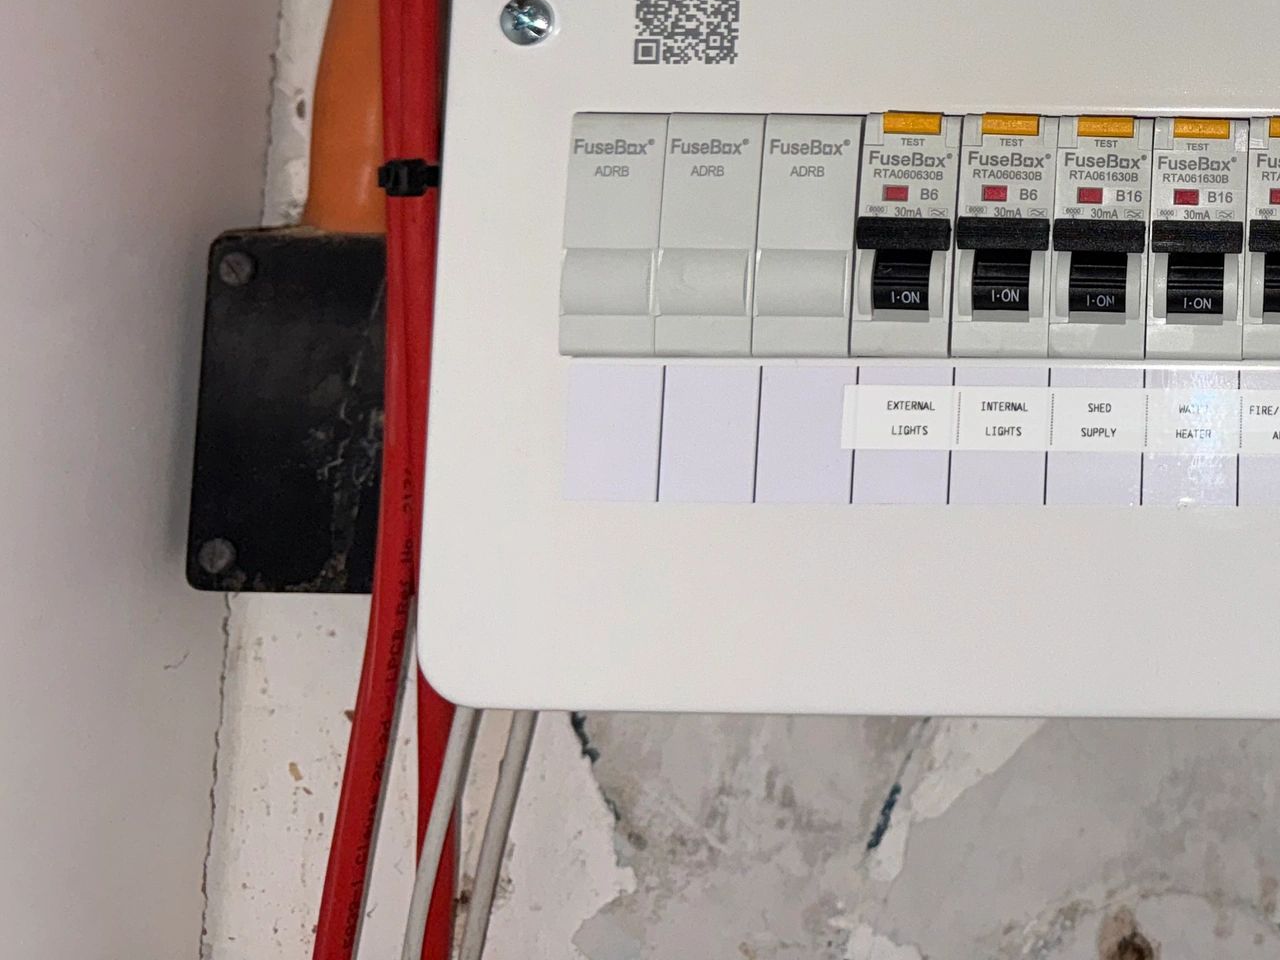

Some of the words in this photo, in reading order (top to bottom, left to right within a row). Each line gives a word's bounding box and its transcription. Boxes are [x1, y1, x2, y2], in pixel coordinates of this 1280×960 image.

[901, 138, 926, 147] TEST
[1000, 138, 1024, 147] TEST
[1095, 140, 1118, 148] TEST
[1186, 143, 1210, 151] TEST
[594, 166, 630, 177] ADRB
[690, 165, 725, 177] ADRB
[790, 166, 825, 178] ADRB
[873, 169, 944, 181] RTA060630B
[973, 169, 1042, 181] RTA060630B
[1069, 171, 1139, 182] RTA061630B
[1163, 173, 1229, 184] RTA061630B
[920, 189, 939, 201] B6
[1020, 189, 1038, 201] B6
[1116, 190, 1143, 202] B16
[1207, 192, 1233, 203] B16
[894, 207, 922, 217] 30mA
[994, 207, 1022, 218] 30mA
[1091, 208, 1118, 219] 30mA
[1184, 210, 1211, 220] 30mA
[887, 400, 936, 411] EXTERNAL
[981, 401, 1029, 412] INTERNAL
[1088, 403, 1112, 413] SHED
[891, 425, 929, 436] LIGHTS
[985, 426, 1022, 437] LIGHTS
[1081, 428, 1117, 438] SUPPLY
[1175, 429, 1212, 439] HEATER
